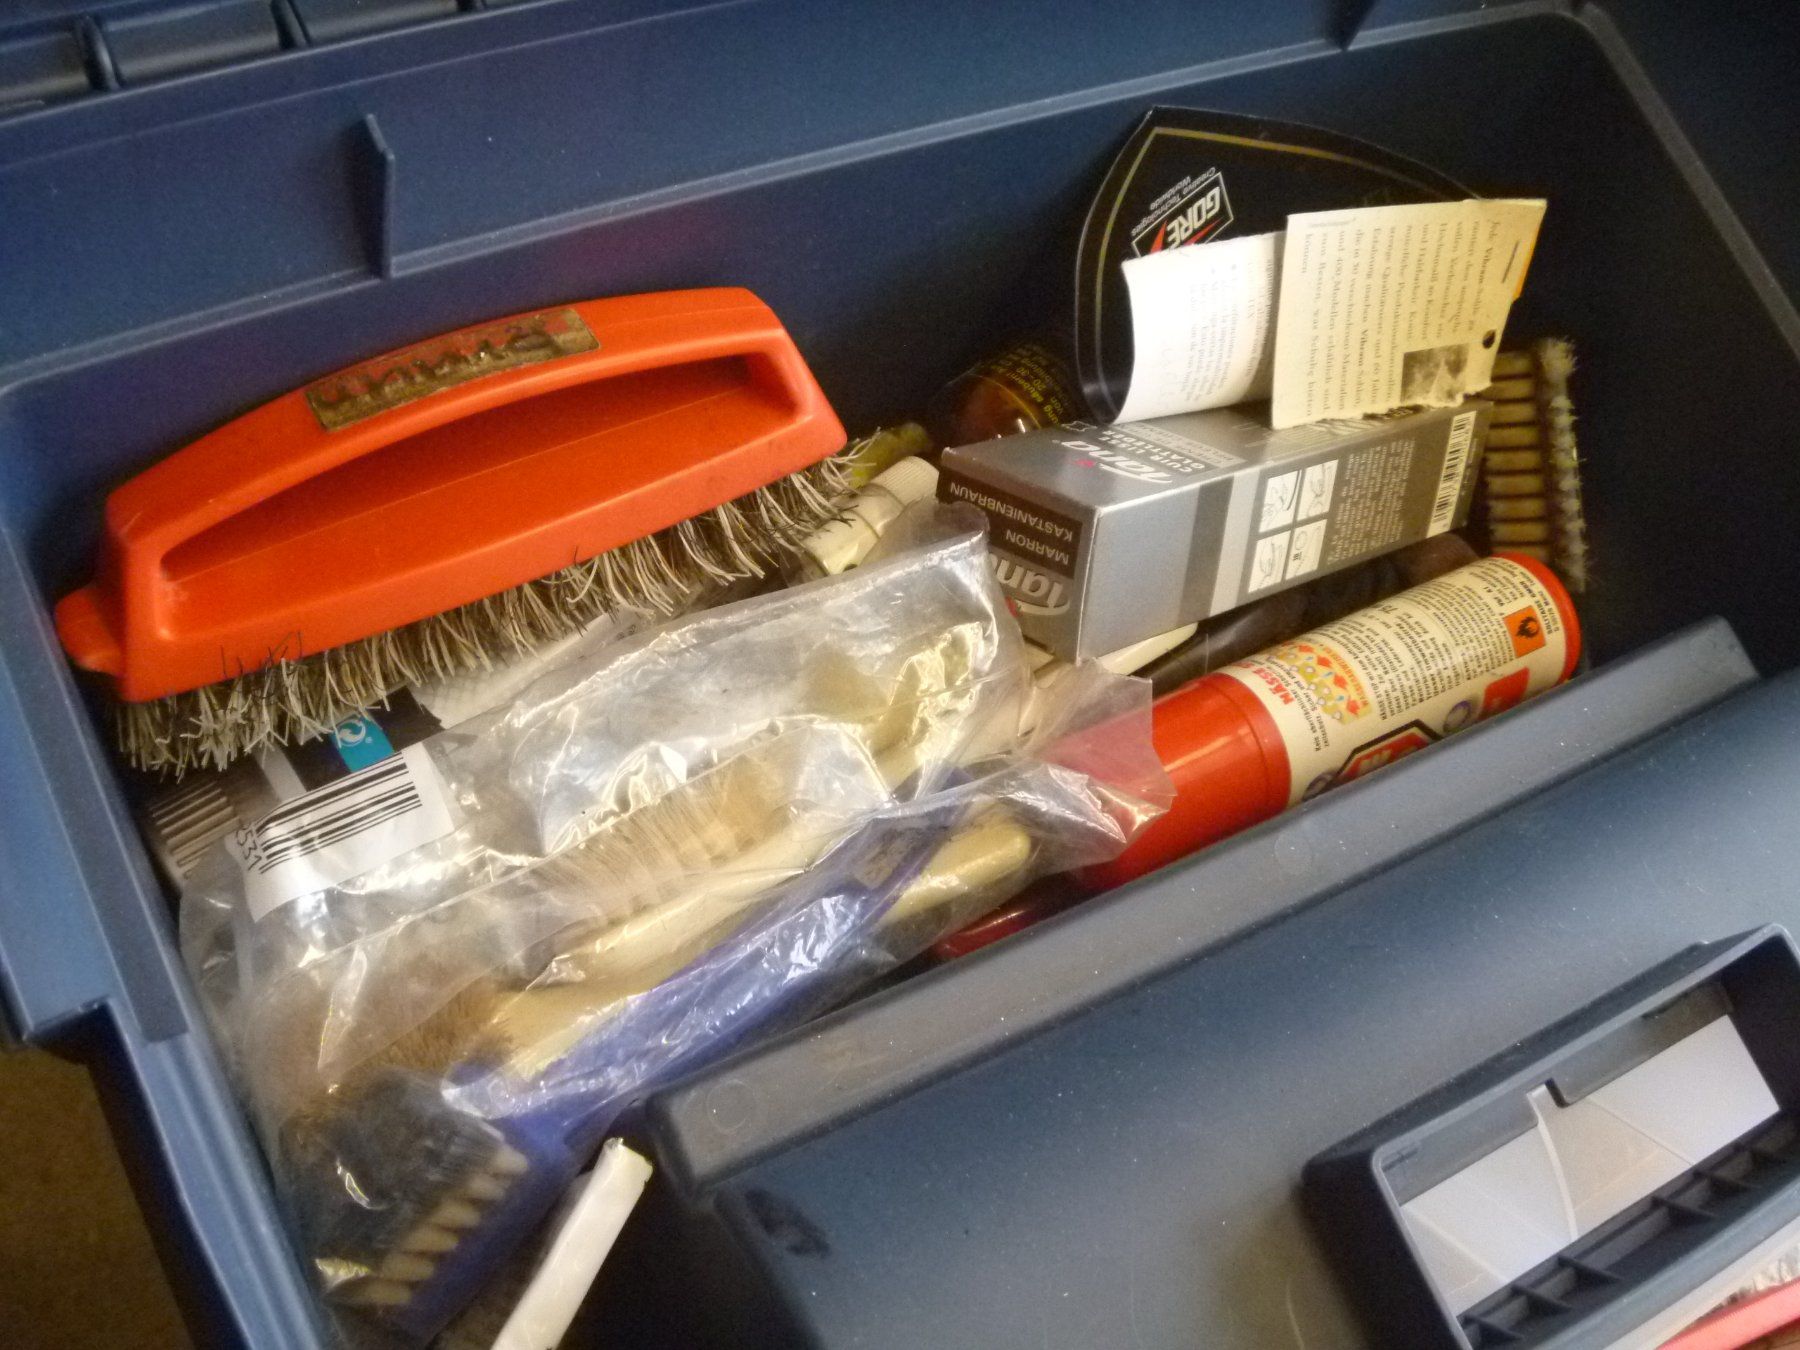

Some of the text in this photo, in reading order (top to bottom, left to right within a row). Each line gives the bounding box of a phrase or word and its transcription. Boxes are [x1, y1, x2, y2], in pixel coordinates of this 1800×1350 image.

[1131, 167, 1216, 236] Creative Technologies
[1150, 175, 1192, 210] Worldwide
[1166, 186, 1221, 249] GORE
[1098, 436, 1193, 473] CUIR LISSE
[1102, 430, 1206, 469] GLATTLEDER
[1061, 440, 1173, 483] Tana
[949, 482, 1074, 541] KASTANIENBRAUN
[1006, 529, 1069, 565] MARRON
[1533, 599, 1553, 635] SOLITAIRE
[1419, 638, 1430, 650] und
[1356, 658, 1368, 671] dem
[1363, 653, 1378, 671] vollen
[1252, 664, 1294, 706] NÄSSE
[1364, 670, 1374, 682] mit
[1375, 673, 1384, 684] Zur
[1386, 677, 1396, 692] über
[1401, 669, 1411, 682] und
[1427, 673, 1439, 696] Unser
[1302, 690, 1317, 712] Sicher
[1370, 681, 1382, 698] STOP
[1406, 684, 1417, 706] Farben
[1376, 699, 1388, 720] NÄSSE
[236, 822, 262, 872] 531
